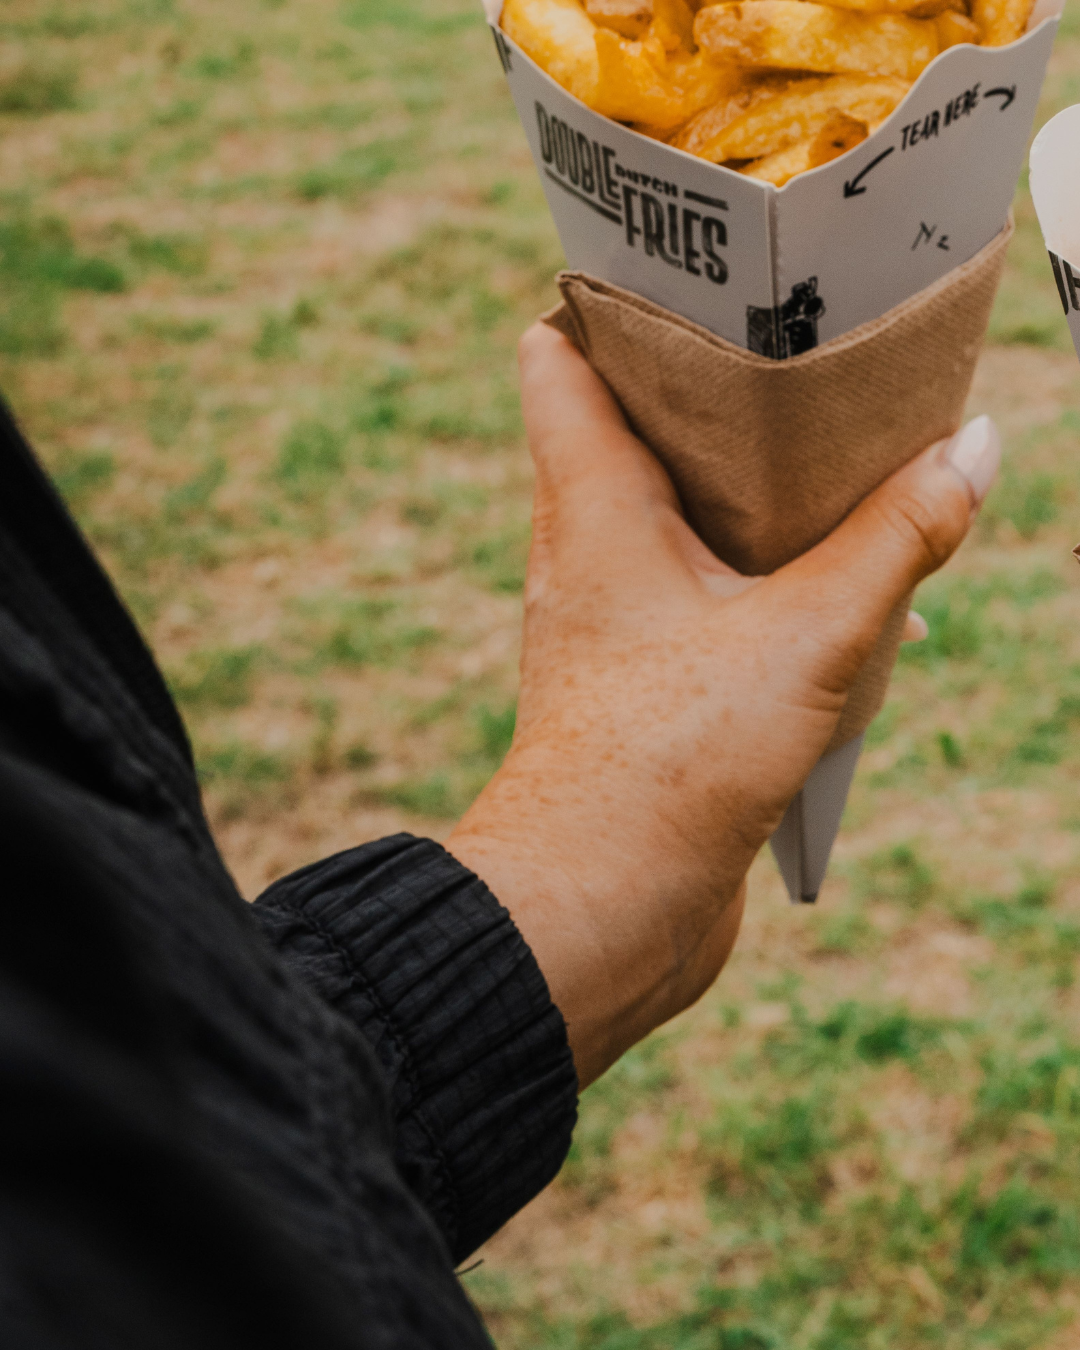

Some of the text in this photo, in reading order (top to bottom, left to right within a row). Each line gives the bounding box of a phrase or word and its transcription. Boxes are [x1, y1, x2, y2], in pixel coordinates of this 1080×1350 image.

[535, 100, 622, 211] DOUBLE
[900, 81, 981, 151] TEAR HERE
[614, 163, 679, 198] DUTCH
[621, 183, 729, 285] FRIES
